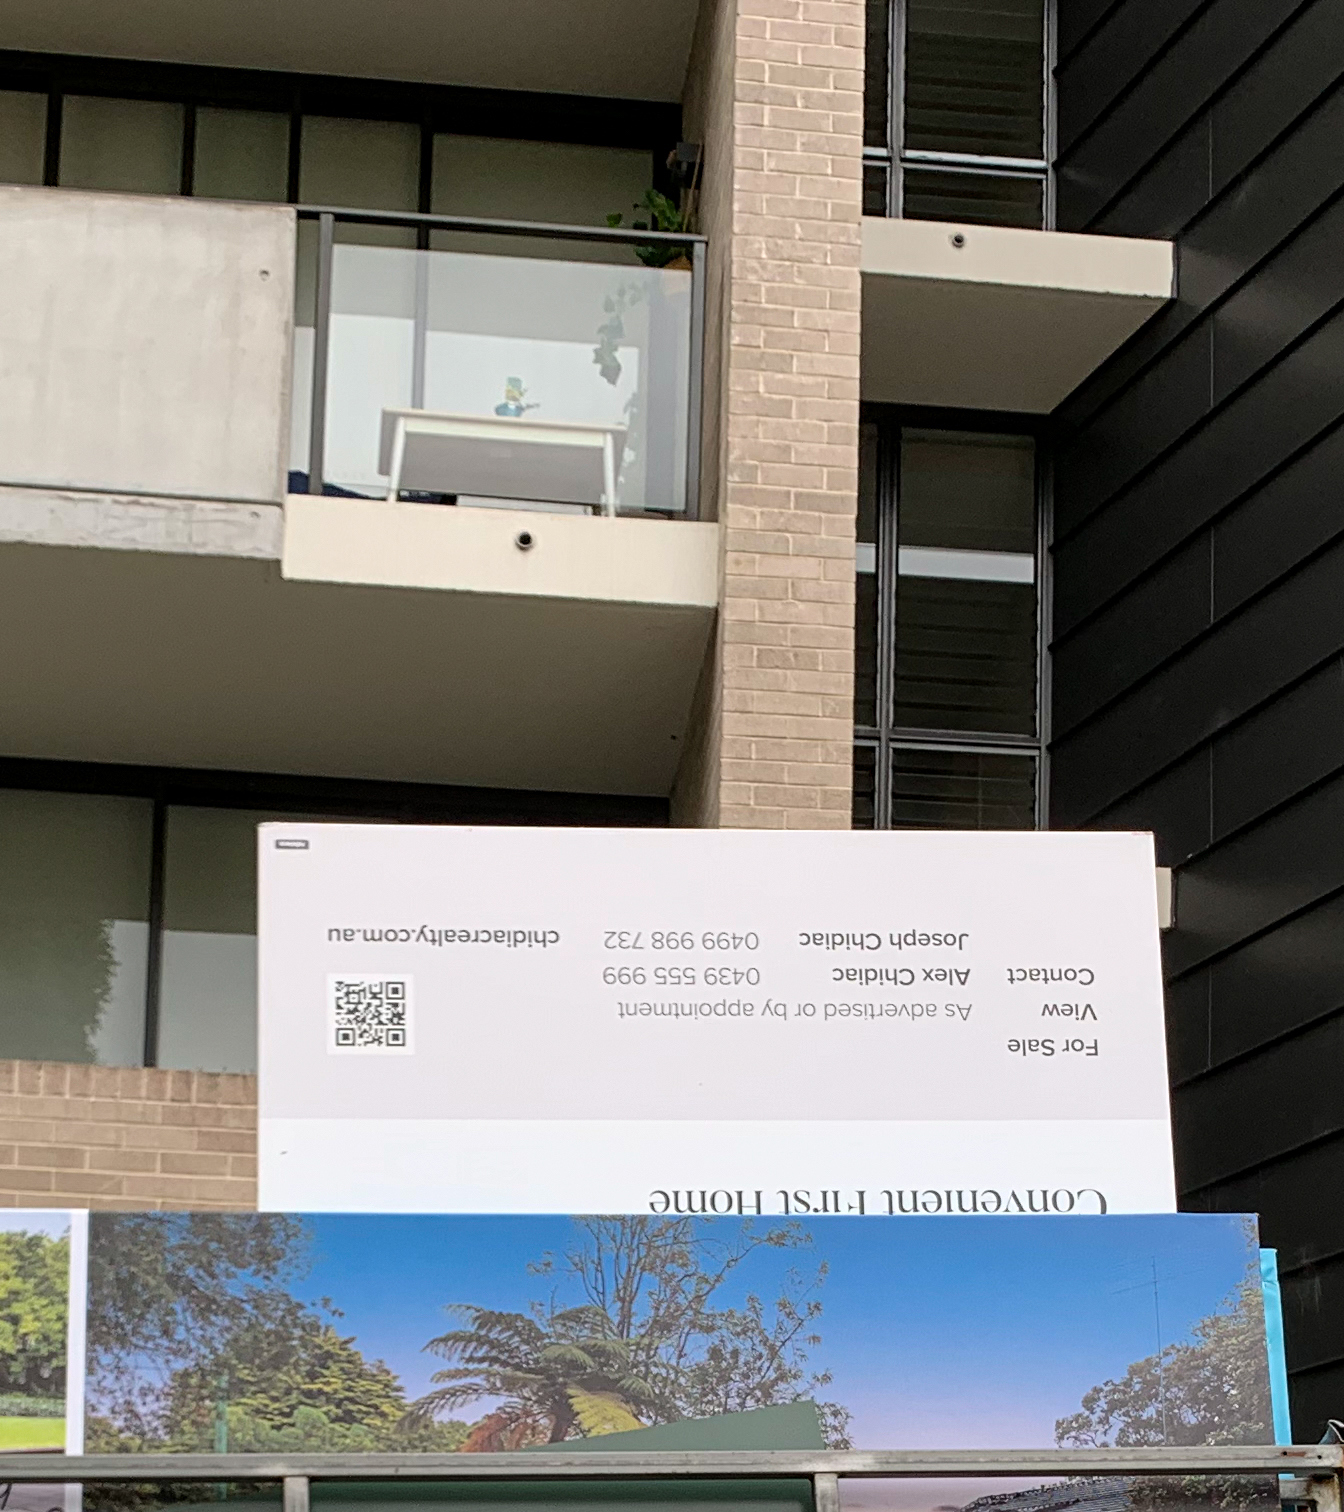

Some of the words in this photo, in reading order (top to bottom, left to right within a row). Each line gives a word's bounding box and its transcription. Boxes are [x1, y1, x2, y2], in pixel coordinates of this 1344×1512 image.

[327, 926, 561, 949] chidiacrealty.com.au
[603, 931, 645, 950] 732
[650, 931, 695, 950] 998
[701, 931, 760, 951] 0499
[798, 932, 882, 951] Chidiac
[889, 928, 970, 951] Joseph
[602, 966, 647, 986] 999
[653, 966, 696, 986] 555
[703, 966, 761, 986] 0439
[832, 967, 916, 986] Chidiac
[921, 968, 971, 986] Alex
[1006, 967, 1095, 986] Contact
[617, 998, 755, 1020] appointment
[760, 998, 788, 1021] by
[794, 1003, 817, 1018] or
[823, 1002, 938, 1022] advertised
[944, 1003, 973, 1022] As
[1041, 1003, 1098, 1021] View
[1007, 1038, 1056, 1057] Sale
[1061, 1038, 1099, 1057] For
[649, 1189, 763, 1214] Home
[777, 1189, 866, 1214] First
[880, 1189, 1108, 1214] Convenient
